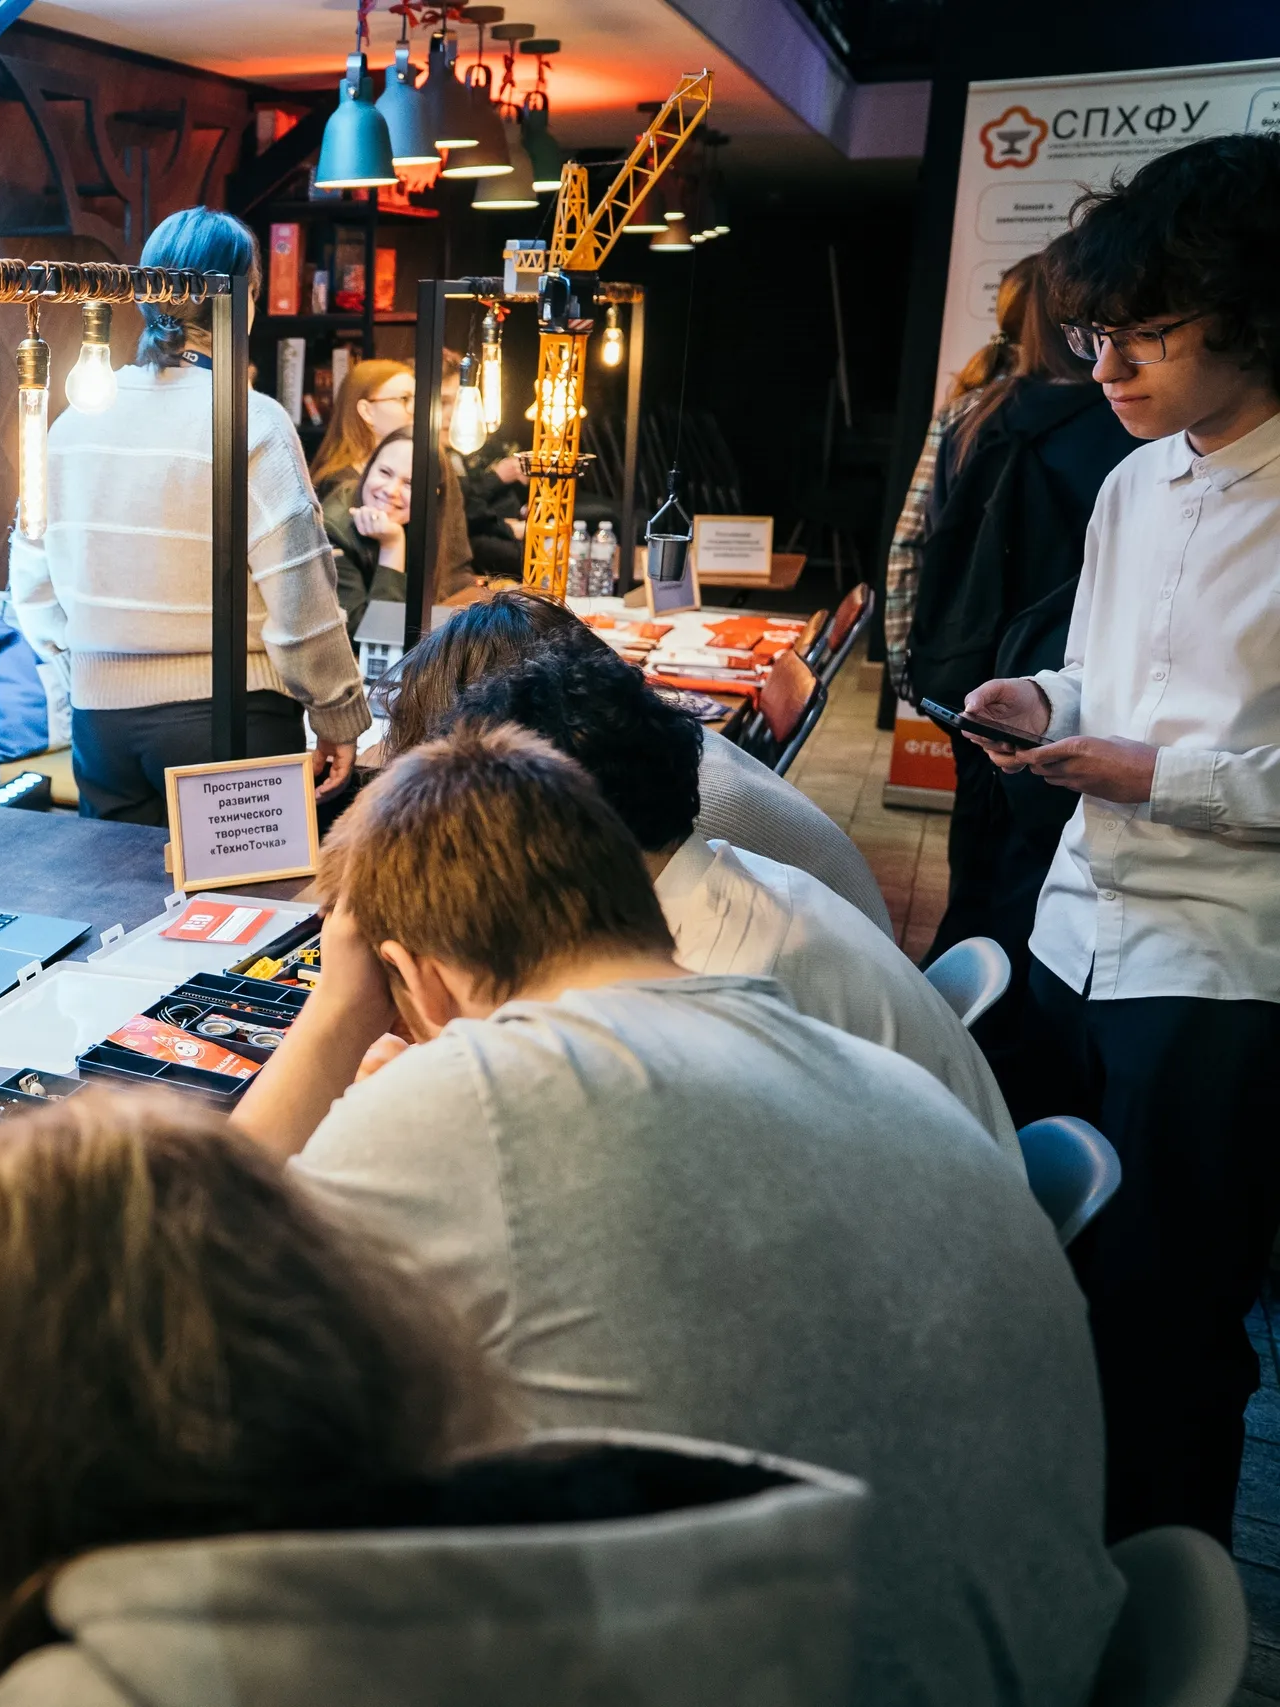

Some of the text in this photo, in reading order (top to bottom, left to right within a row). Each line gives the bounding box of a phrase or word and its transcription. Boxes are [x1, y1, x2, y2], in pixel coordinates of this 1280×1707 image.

[1052, 100, 1210, 139] СПХФУ
[203, 776, 282, 795] Пространство
[218, 793, 270, 809] развития
[208, 807, 283, 825] технического
[214, 823, 279, 840] творчества
[210, 838, 287, 856] «ТехноТочка»
